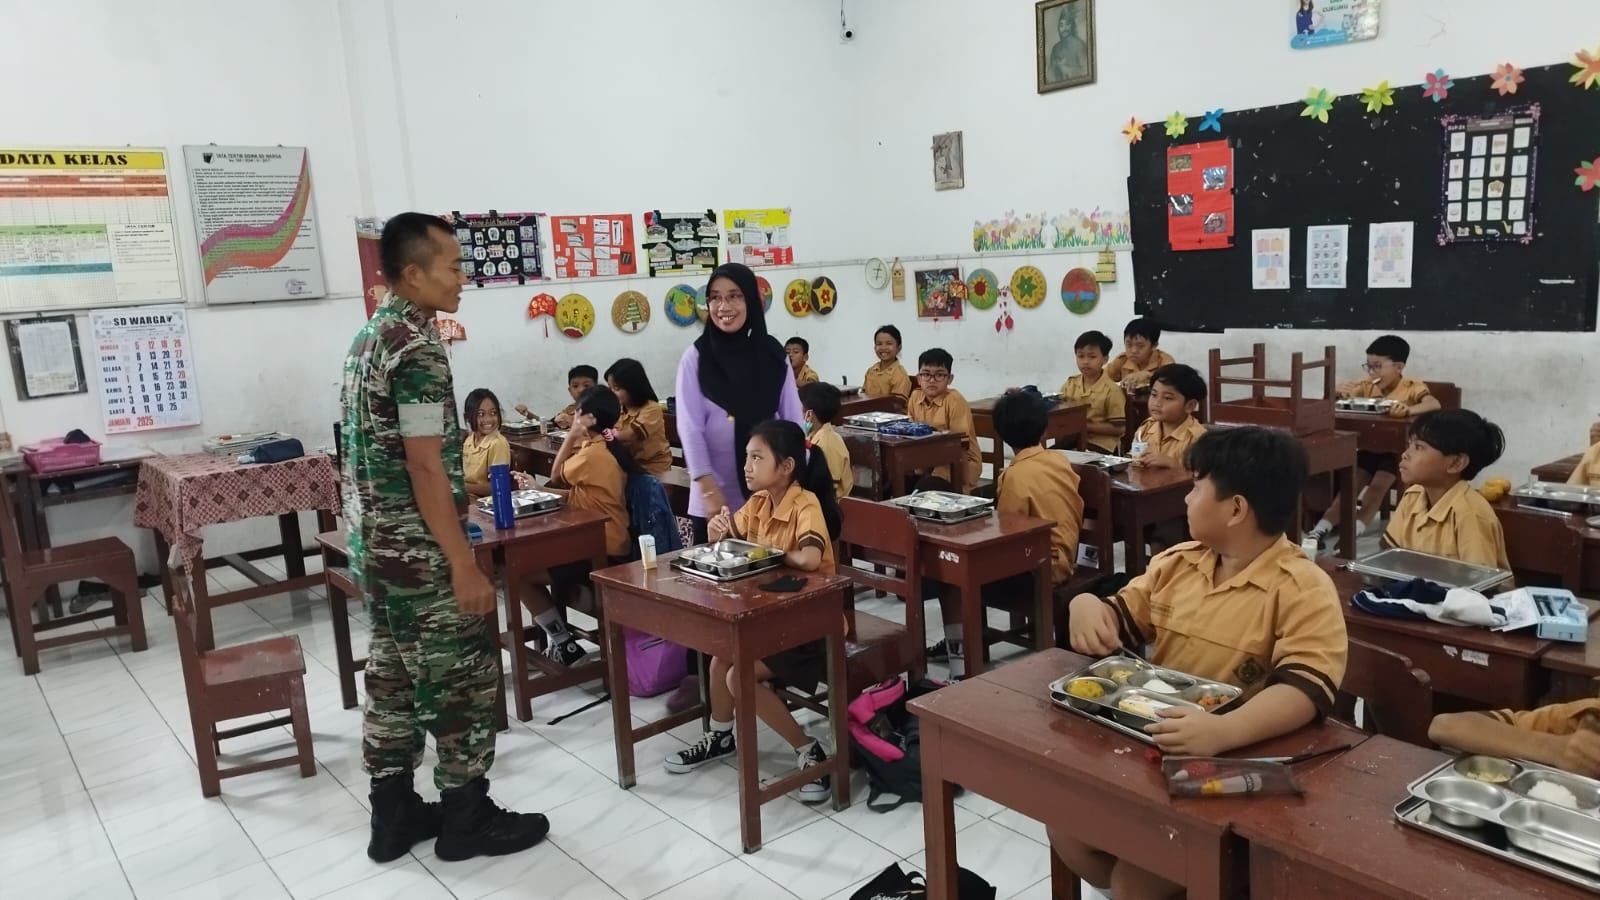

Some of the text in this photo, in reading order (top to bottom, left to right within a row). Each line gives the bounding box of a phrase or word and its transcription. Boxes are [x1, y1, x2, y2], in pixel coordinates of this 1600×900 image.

[0, 153, 128, 166] DATA KELAS
[113, 317, 127, 326] SD
[129, 316, 166, 325] WARGA
[148, 340, 155, 349] 12
[150, 352, 156, 360] 13
[162, 351, 170, 359] 20
[175, 350, 182, 358] 27
[139, 363, 142, 372] 7
[151, 362, 158, 370] 14
[164, 361, 171, 370] 21
[176, 360, 184, 369] 28
[153, 372, 159, 381] 15
[165, 371, 173, 380] 22
[128, 385, 132, 394] 2
[154, 383, 161, 391] 16
[167, 382, 174, 390] 23
[179, 381, 187, 389] 30
[129, 396, 134, 405] 3
[143, 394, 150, 403] 10
[156, 393, 162, 402] 17
[168, 392, 176, 401] 24
[180, 391, 187, 400] 31
[131, 406, 136, 414] 4
[144, 405, 150, 414] 11
[157, 404, 164, 412] 18
[169, 402, 178, 411] 25
[137, 415, 153, 426] 2025
